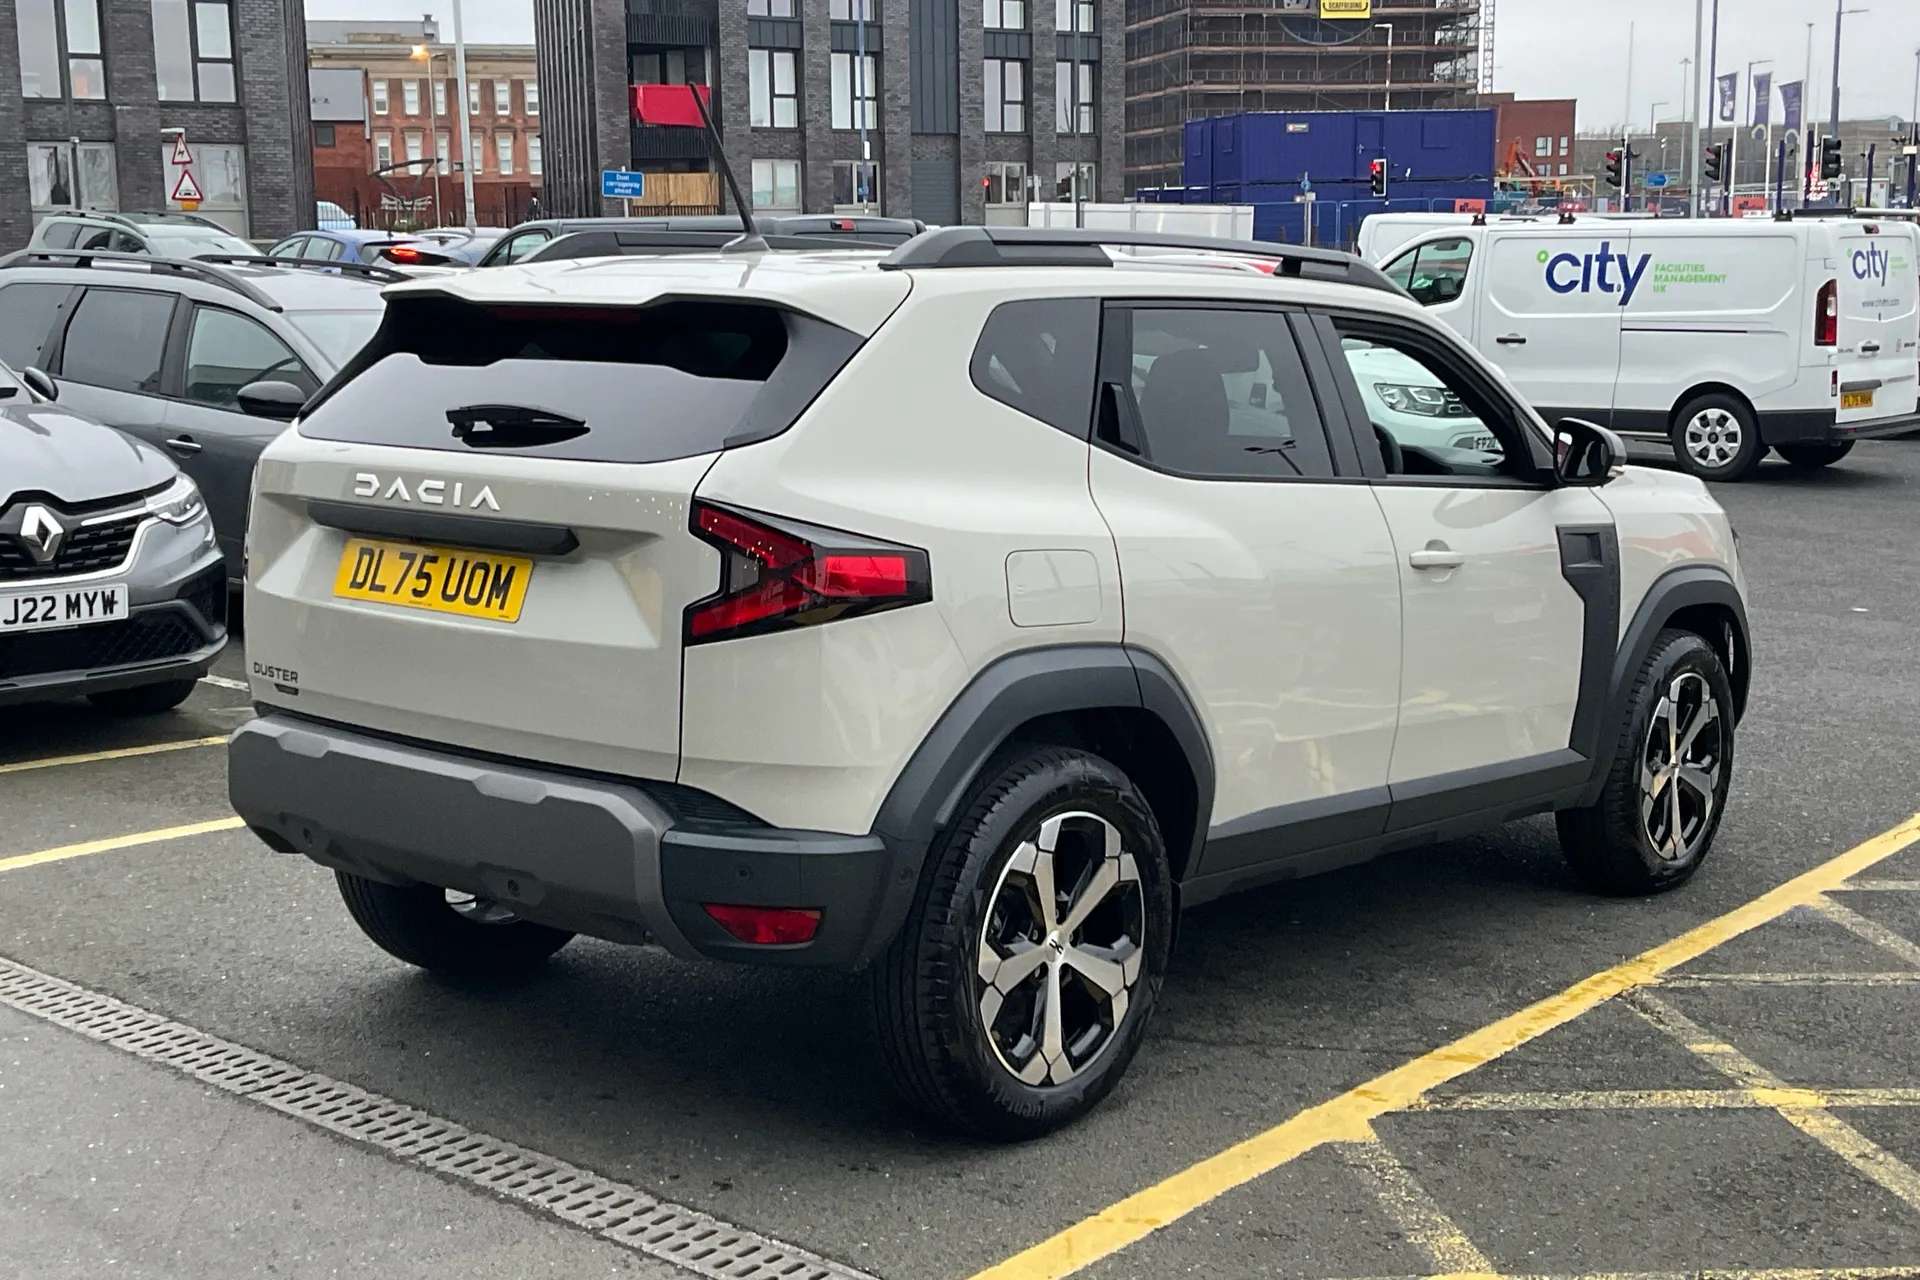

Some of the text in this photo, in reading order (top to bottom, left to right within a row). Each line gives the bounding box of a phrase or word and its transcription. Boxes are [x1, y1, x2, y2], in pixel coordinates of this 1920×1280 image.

[1654, 274, 1727, 284] MANAGEMENT
[1655, 263, 1705, 273] FACILITIES
[1653, 285, 1666, 293] UK
[355, 473, 500, 511] DACIA
[349, 547, 517, 610] DL75 UOM
[65, 590, 116, 619] MYW
[253, 661, 298, 683] DUSTER
